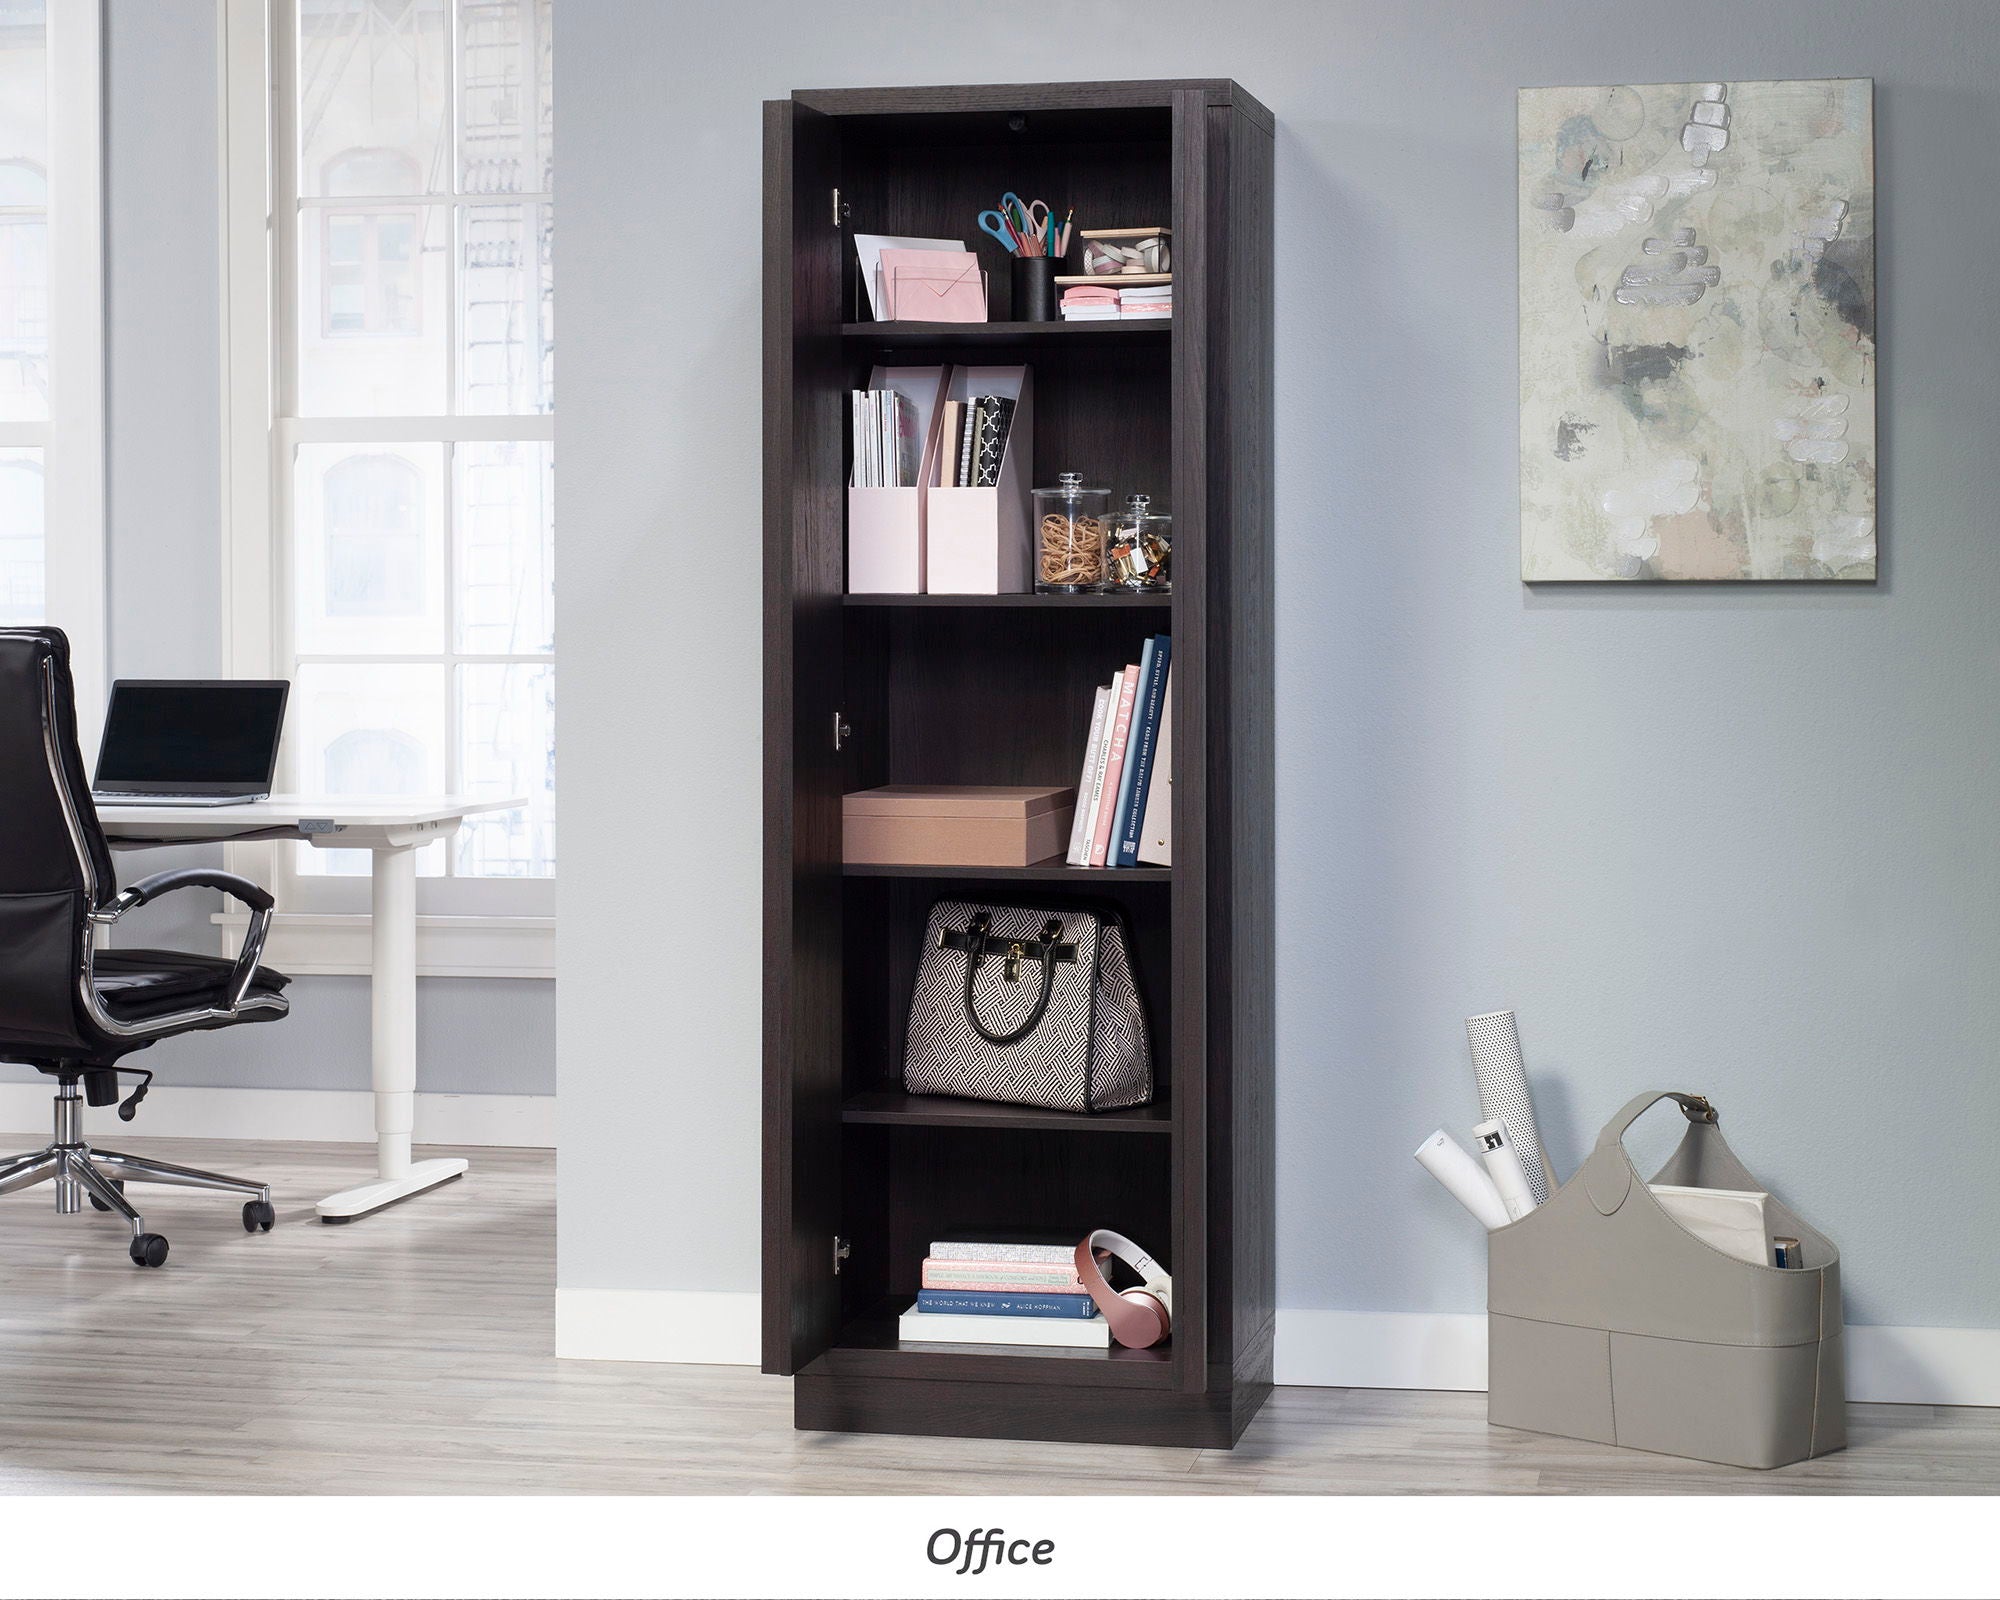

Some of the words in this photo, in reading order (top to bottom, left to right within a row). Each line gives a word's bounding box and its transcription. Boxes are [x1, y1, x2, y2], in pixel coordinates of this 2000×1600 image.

[1096, 699, 1106, 719] COOK
[1091, 721, 1102, 741] YOUR
[1111, 681, 1134, 762] MATCHA
[1099, 739, 1109, 764] CHARLES
[1093, 782, 1101, 801] EAMES
[1082, 839, 1090, 860] TASCHEN
